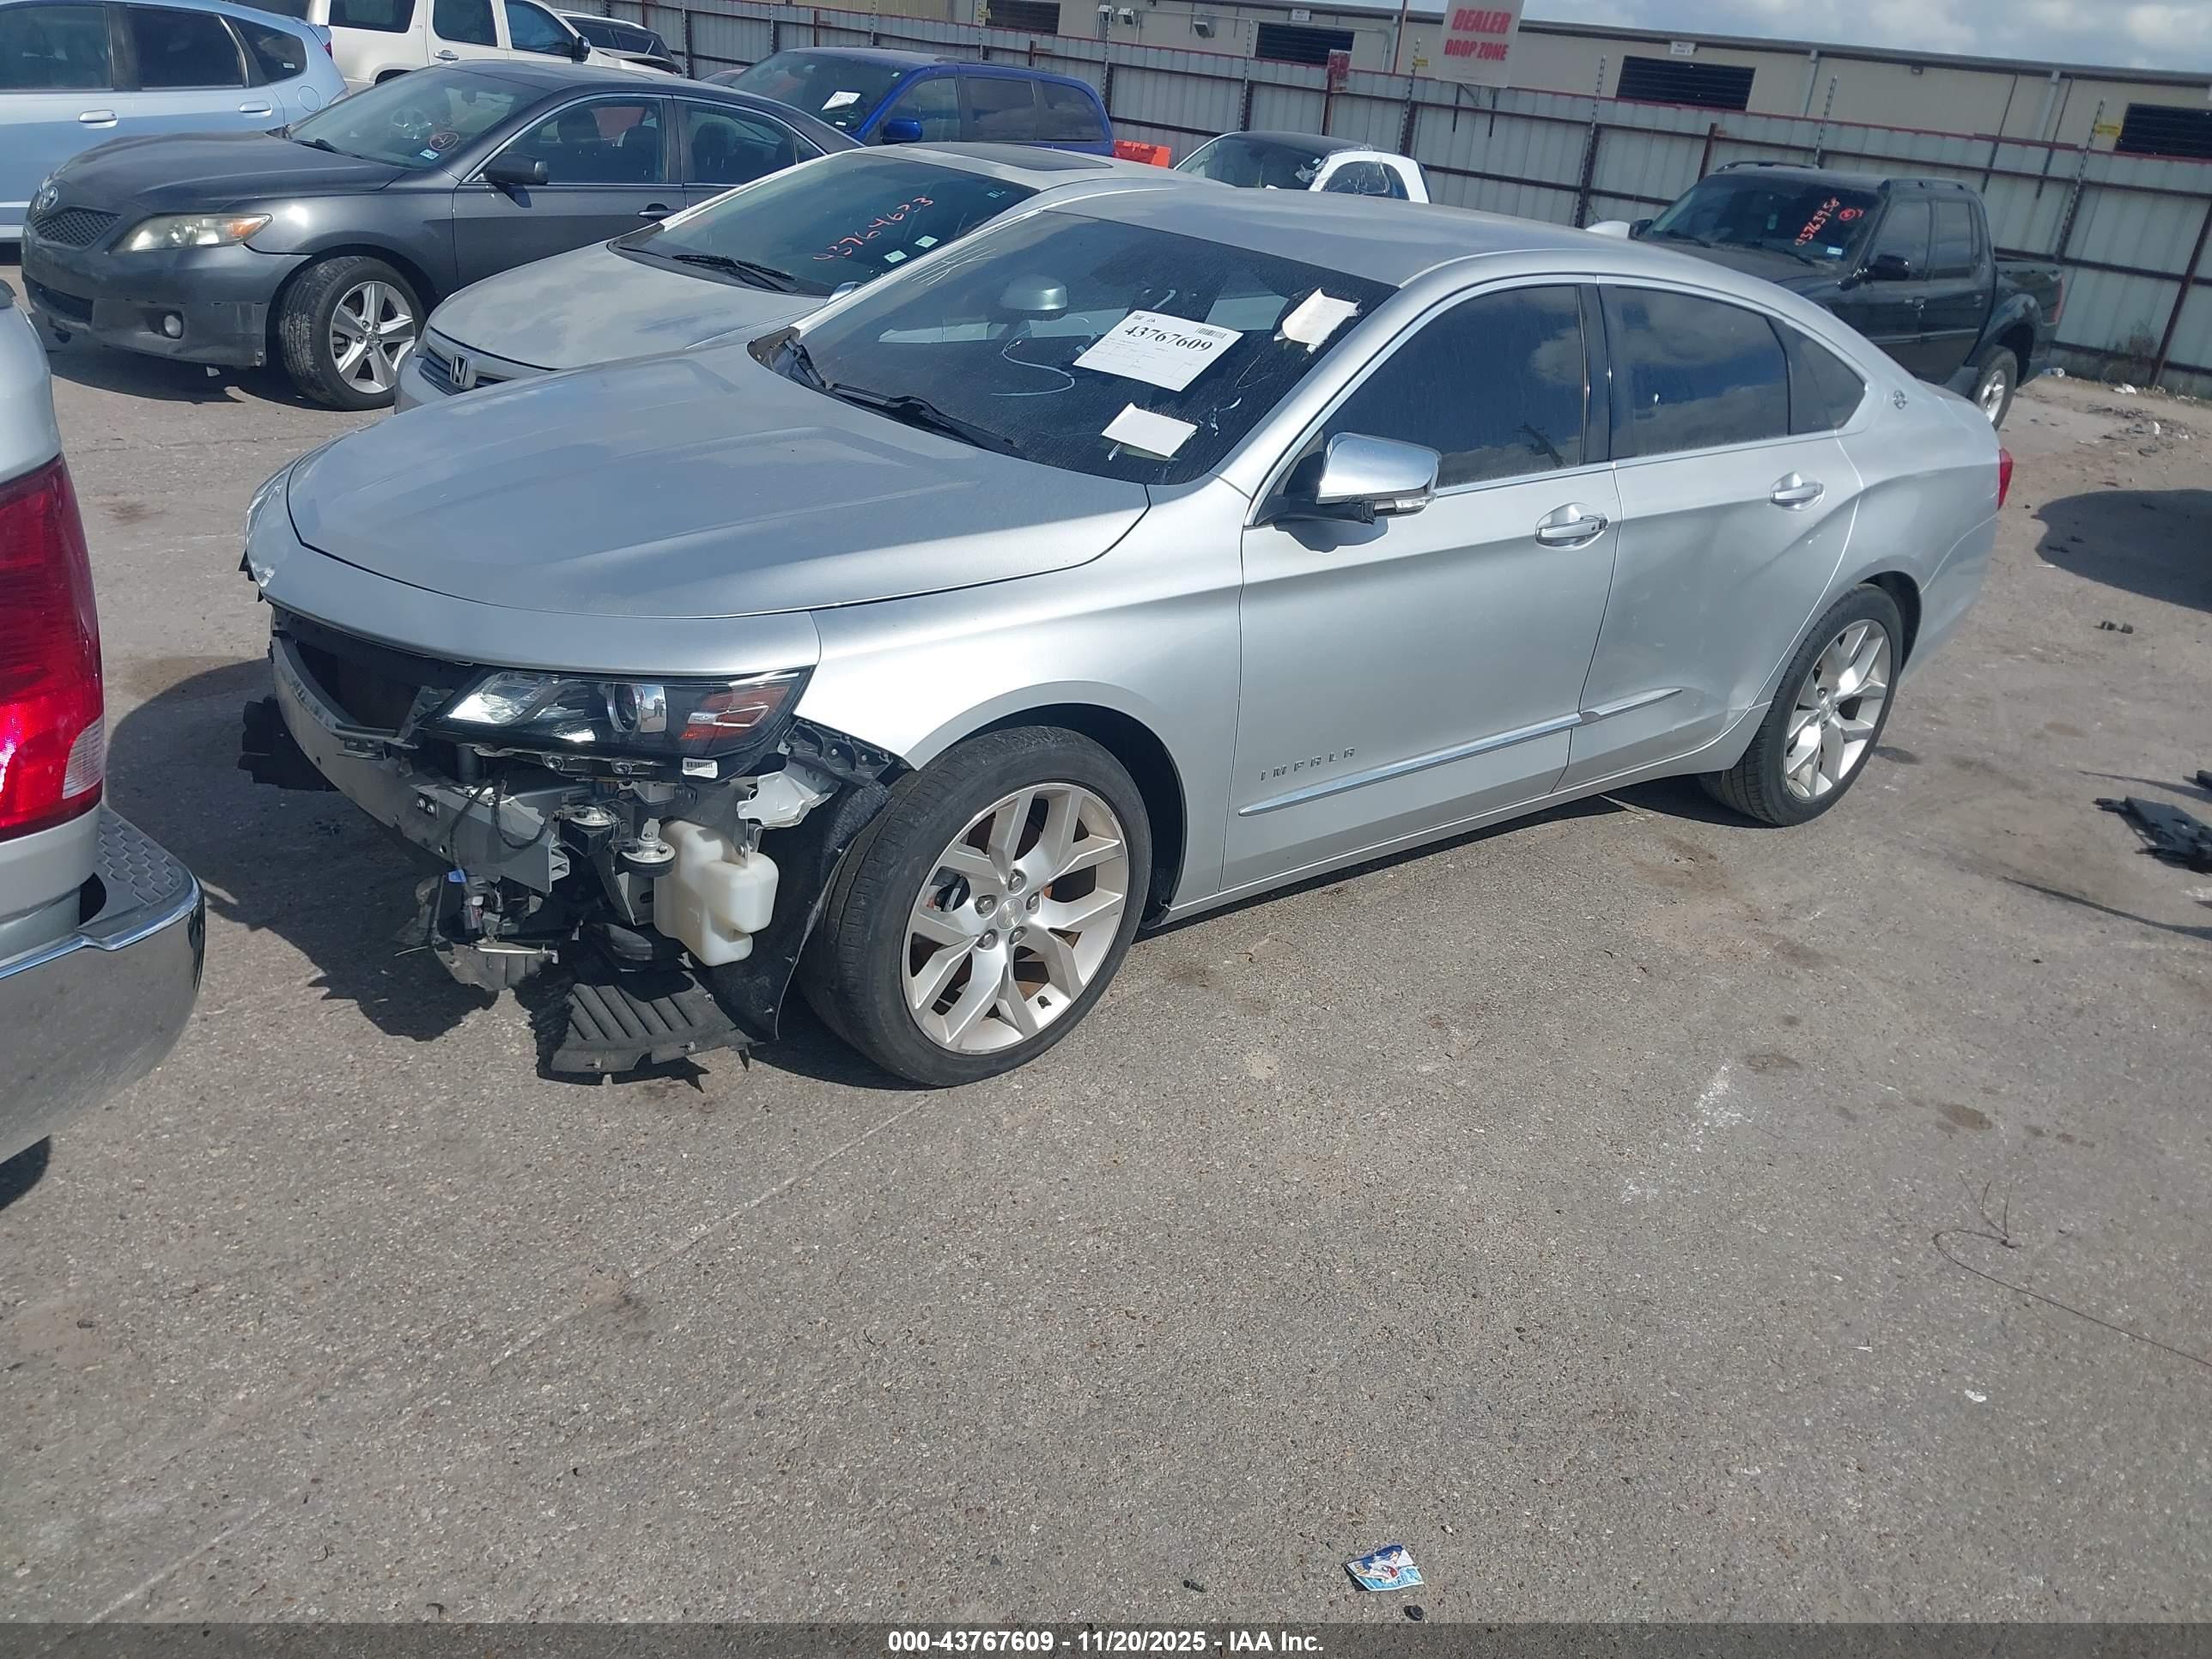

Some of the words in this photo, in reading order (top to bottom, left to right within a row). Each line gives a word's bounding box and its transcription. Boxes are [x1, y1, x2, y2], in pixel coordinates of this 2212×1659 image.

[1451, 9, 1511, 34] DEALER
[1443, 39, 1478, 58] DROP
[1477, 41, 1509, 61] ZONE
[1124, 325, 1213, 352] 43767609
[1260, 746, 1355, 781] IMPALA
